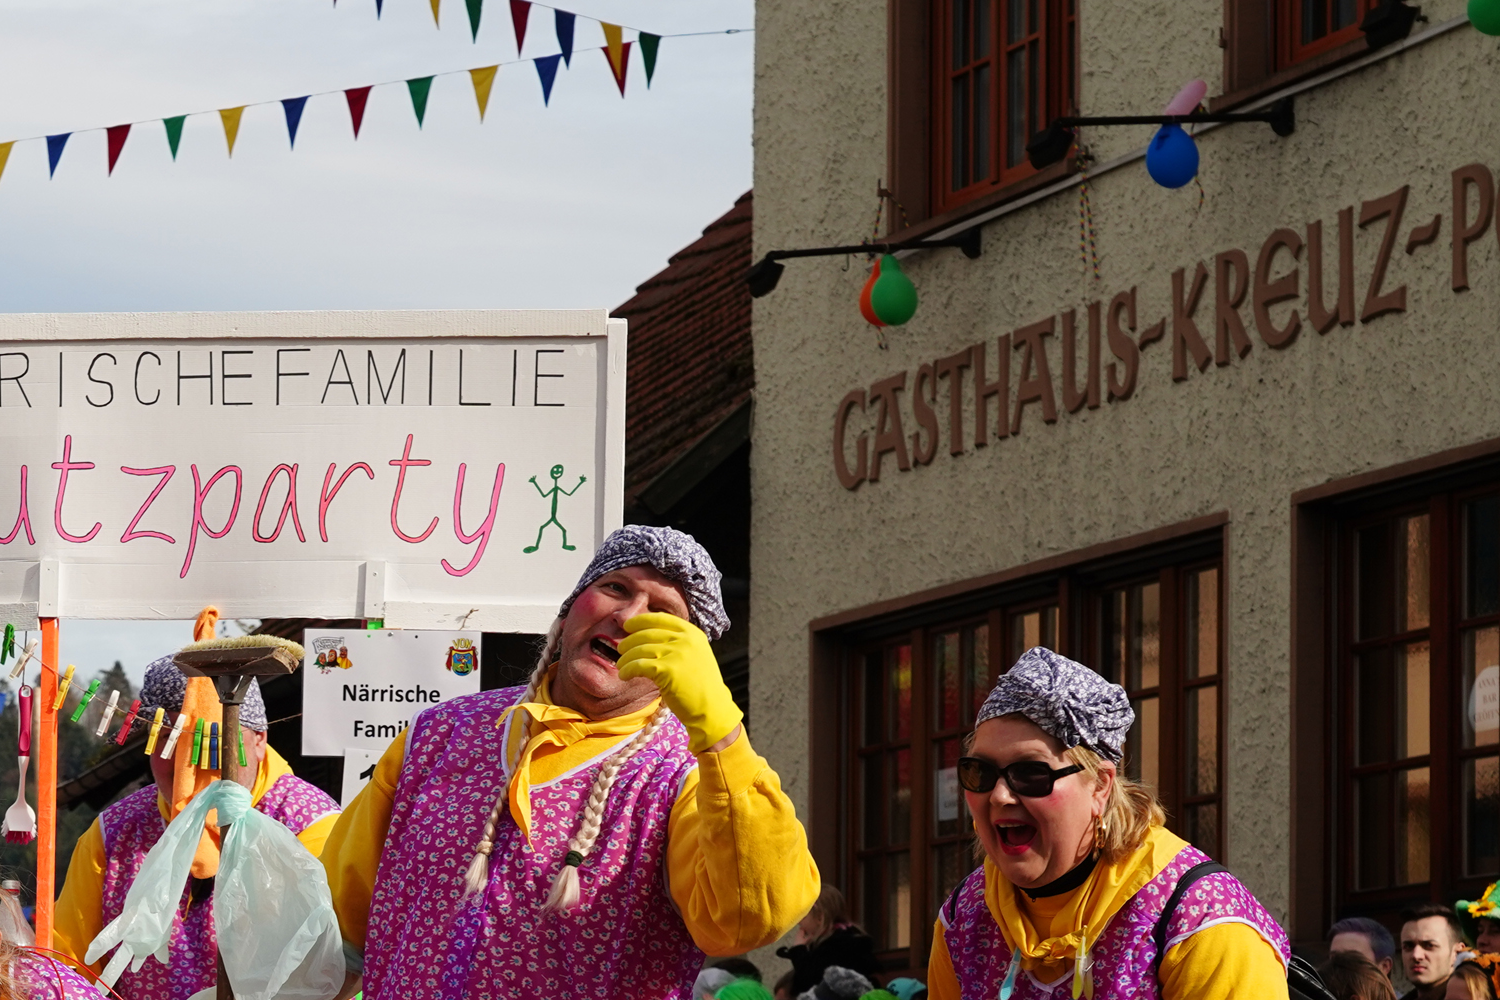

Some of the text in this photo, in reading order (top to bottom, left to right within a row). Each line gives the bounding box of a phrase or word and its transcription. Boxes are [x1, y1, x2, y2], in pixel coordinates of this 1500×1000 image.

[833, 162, 1500, 492] GASTHAUS-KREUZ-P
[342, 684, 440, 703] Närrische
[354, 720, 408, 738] Fami
